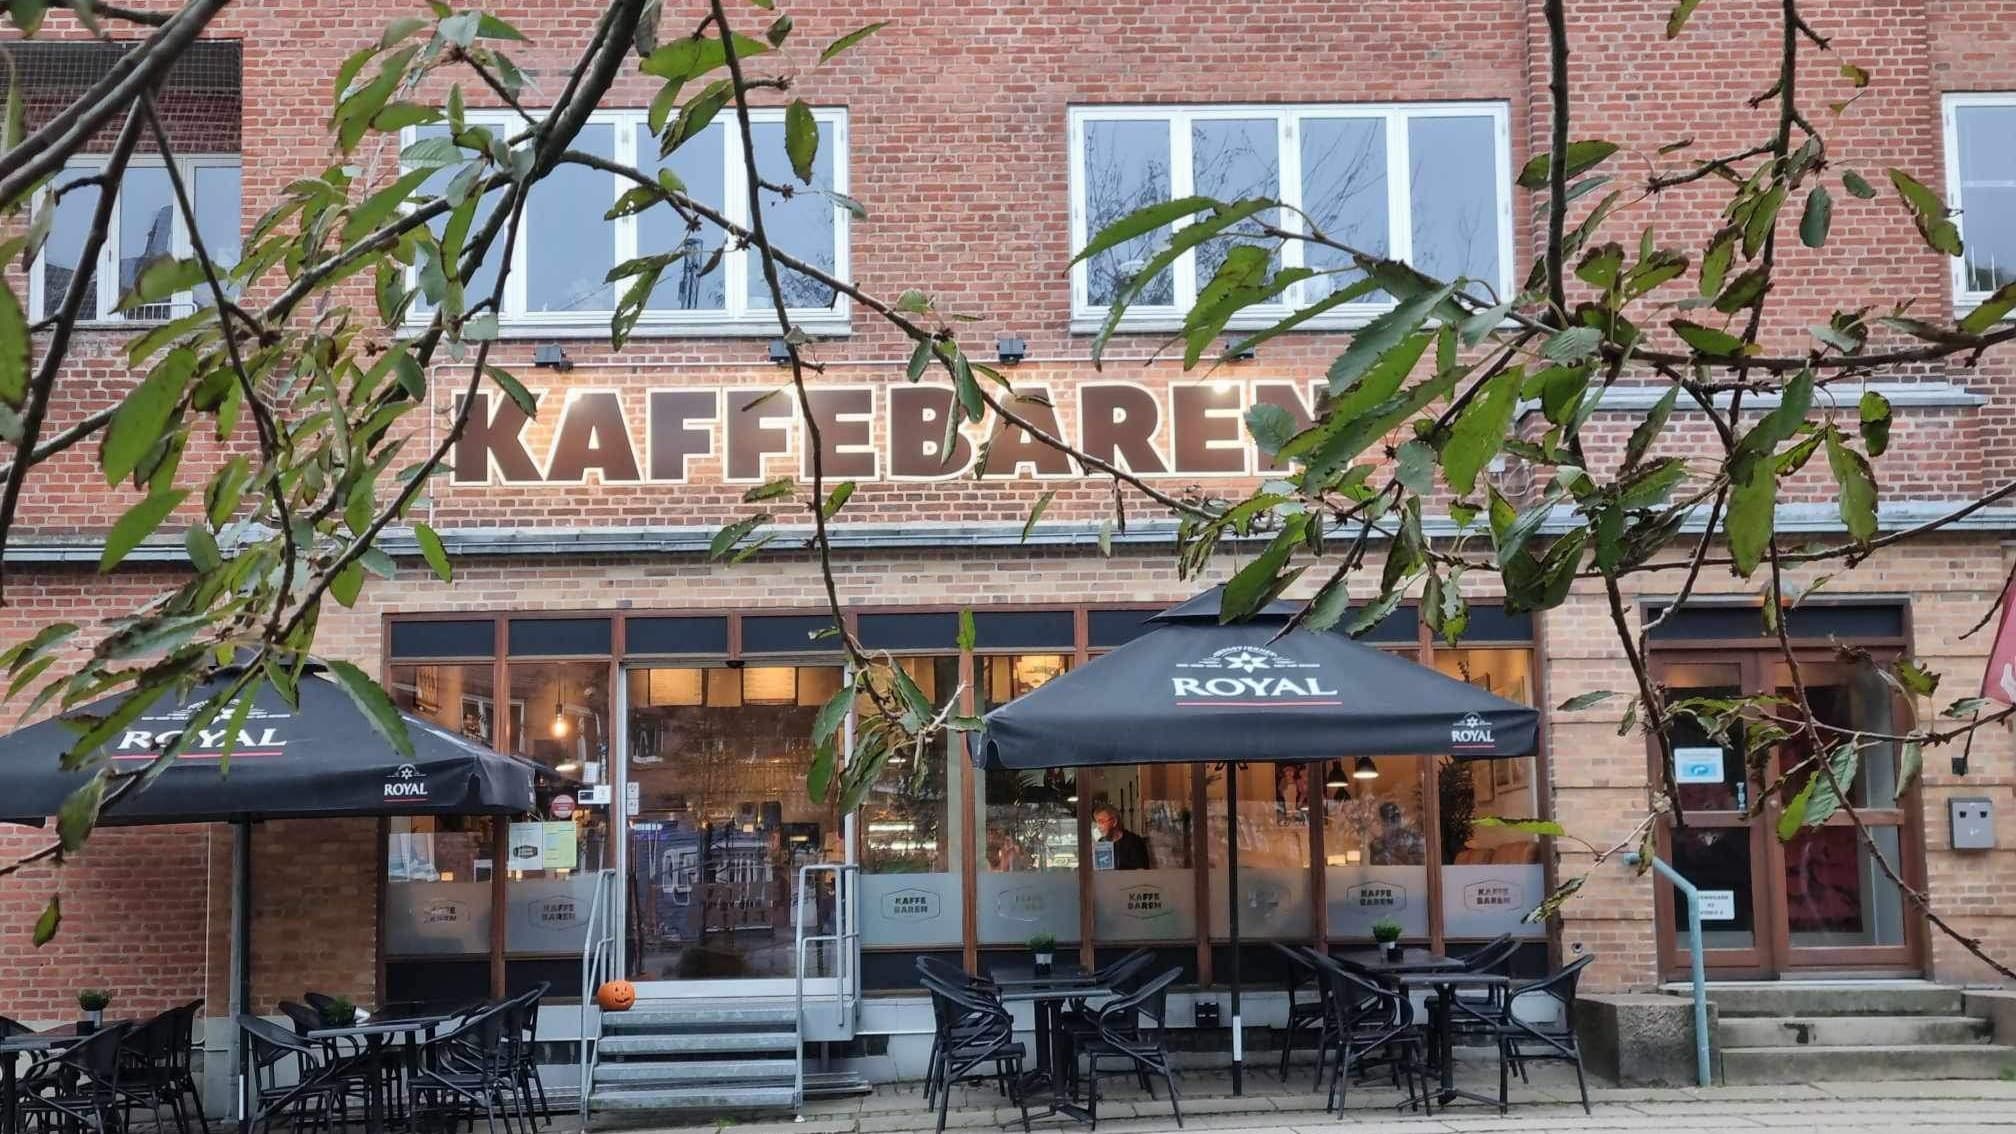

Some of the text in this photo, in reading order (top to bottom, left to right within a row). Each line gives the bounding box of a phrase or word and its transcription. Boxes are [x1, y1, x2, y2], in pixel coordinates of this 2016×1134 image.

[1171, 677, 1338, 697] ROYAL
[1451, 729, 1495, 742] ROYAL
[383, 782, 428, 796] ROYAL
